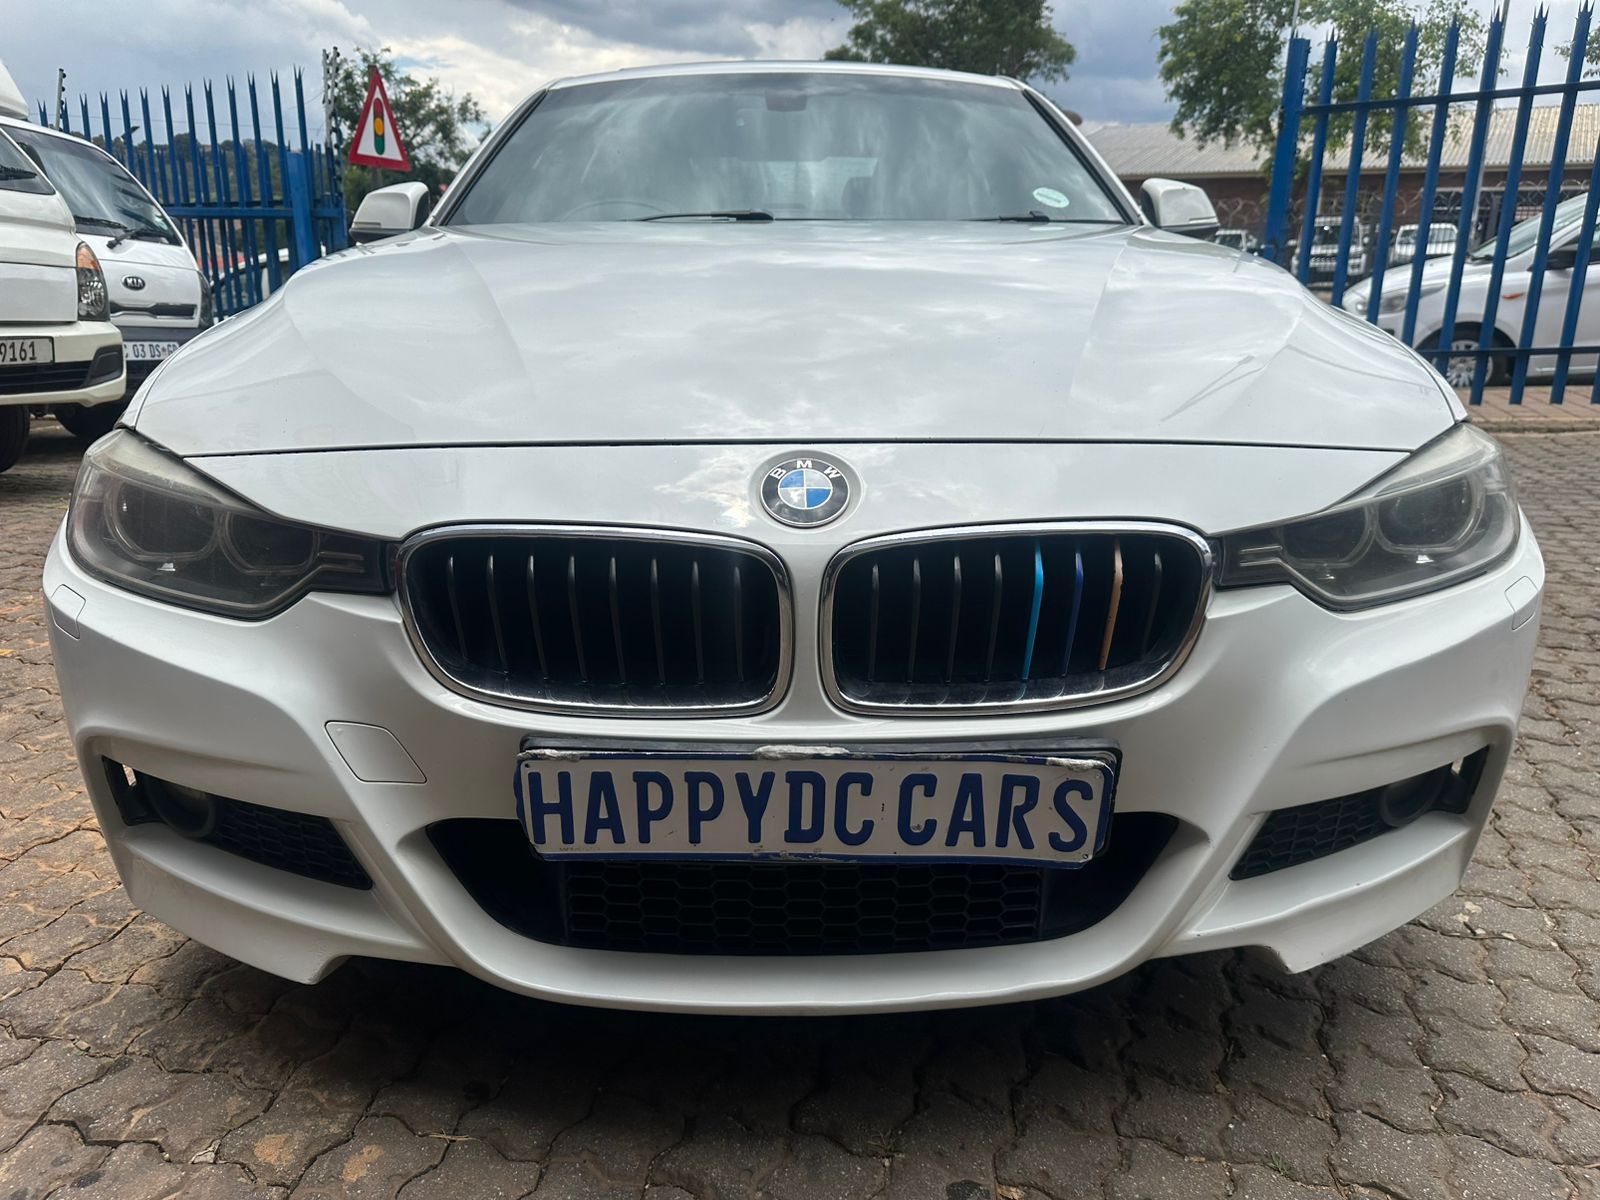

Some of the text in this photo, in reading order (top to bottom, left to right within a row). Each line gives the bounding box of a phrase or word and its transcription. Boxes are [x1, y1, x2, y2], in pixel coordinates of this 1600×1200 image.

[126, 277, 144, 288] KIA
[0, 341, 37, 362] 9161
[132, 343, 146, 358] 03
[148, 343, 161, 358] DS
[770, 459, 841, 480] BMW
[528, 771, 1094, 852] HAPPYDC CARS
